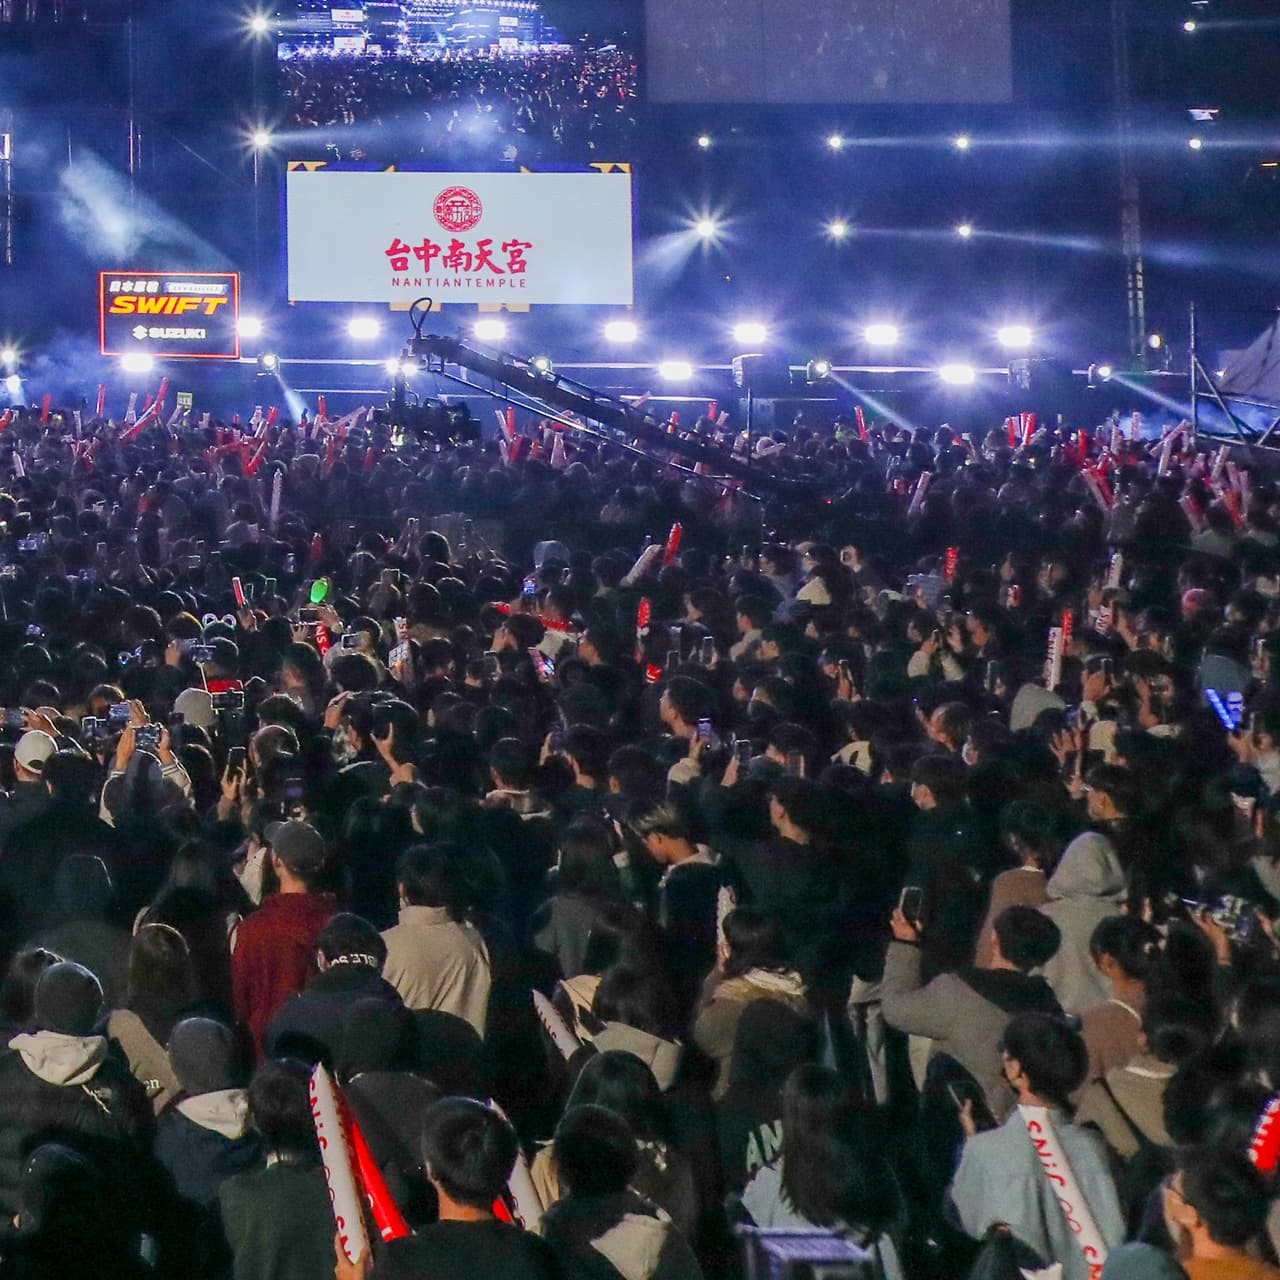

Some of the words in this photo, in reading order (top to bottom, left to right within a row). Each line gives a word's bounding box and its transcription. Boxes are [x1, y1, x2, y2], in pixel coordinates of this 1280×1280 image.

[385, 238, 533, 274] 台中南天宮
[392, 277, 527, 288] NANTIANTEMPLE
[109, 295, 229, 315] SWIFT
[148, 327, 207, 339] SUZUKI
